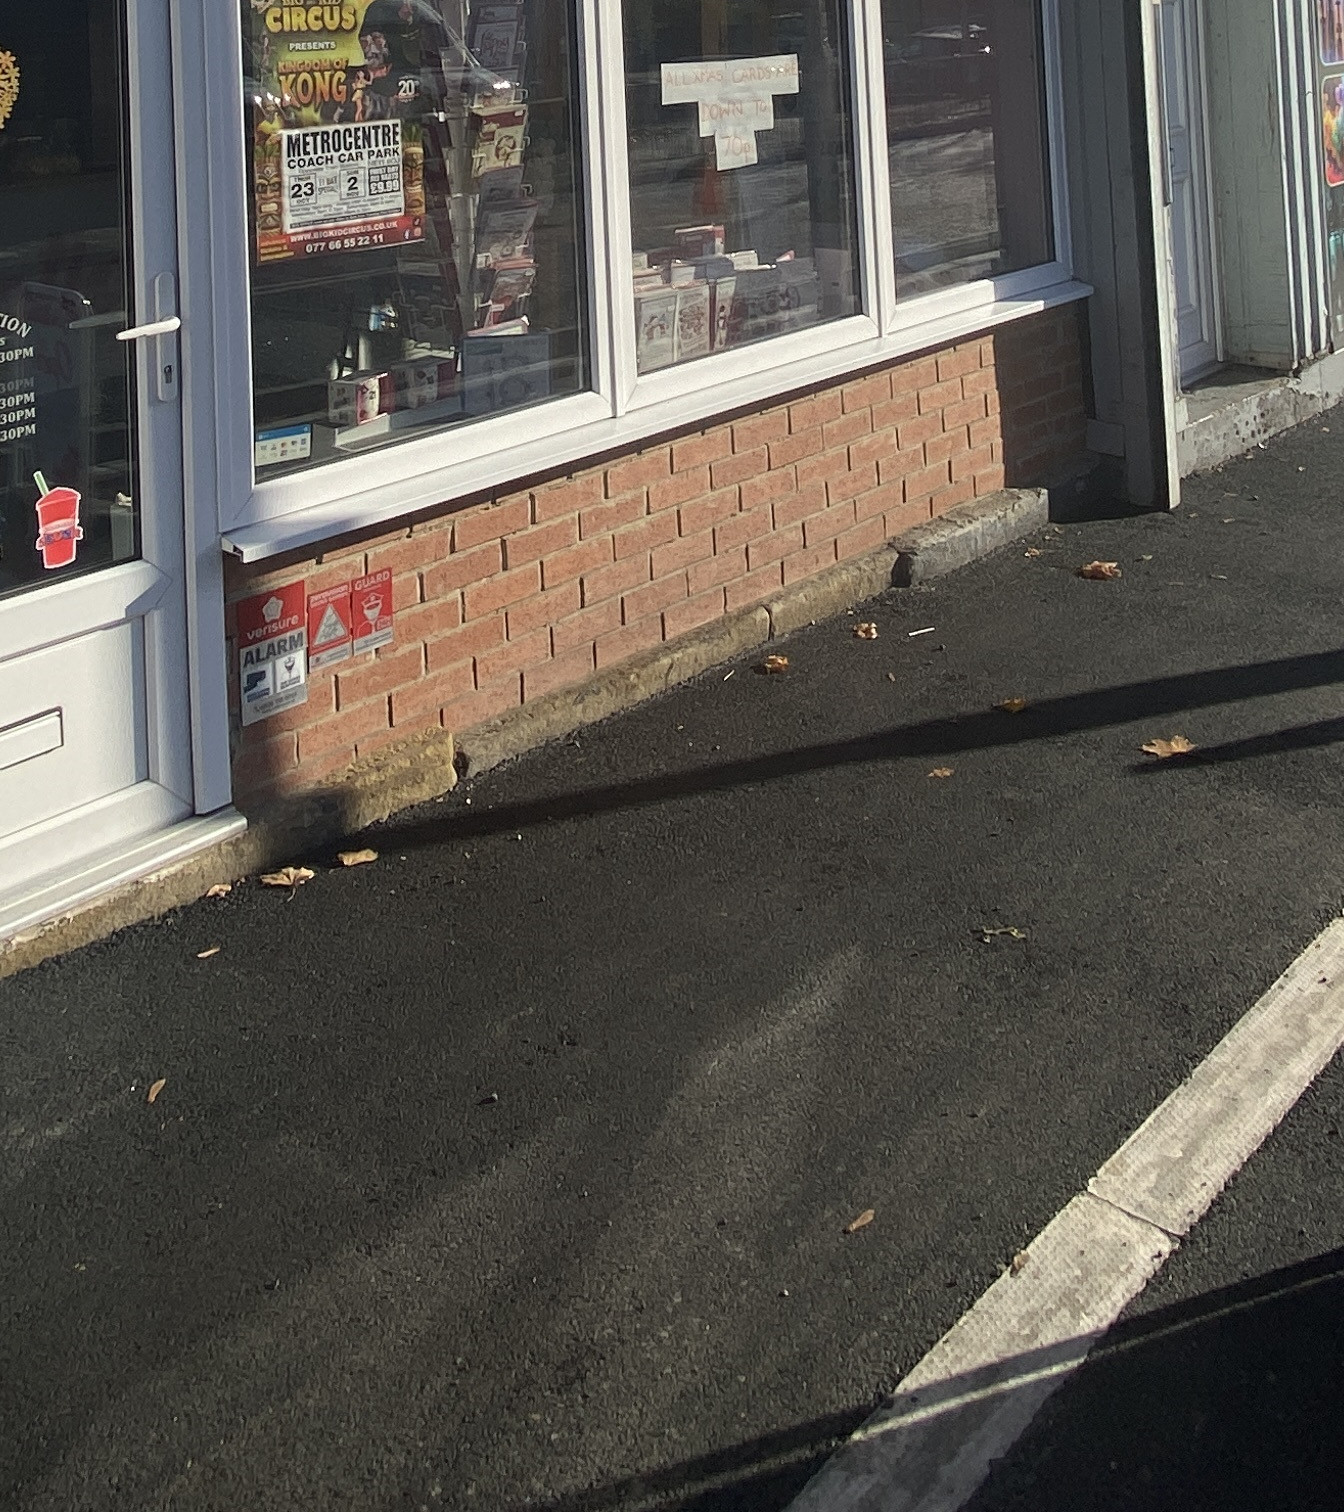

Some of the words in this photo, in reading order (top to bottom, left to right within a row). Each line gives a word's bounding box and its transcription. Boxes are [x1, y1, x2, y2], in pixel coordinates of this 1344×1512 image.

[264, 4, 356, 34] CIRCUS
[288, 41, 337, 52] PRESENTS
[277, 59, 333, 74] KINGDOM
[278, 69, 348, 109] KONG
[286, 123, 400, 159] METROCENTRE
[287, 154, 334, 170] COACH
[338, 150, 364, 164] CAR
[367, 146, 400, 160] PARK
[291, 182, 315, 199] 23
[347, 176, 359, 192] 2
[369, 179, 400, 195] £9.99
[305, 242, 326, 254] 077
[328, 239, 342, 250] 66
[343, 237, 356, 248] 55
[357, 235, 371, 246] 22
[373, 233, 384, 244] 11
[354, 570, 391, 591] GUARD
[246, 614, 300, 641] verisure
[242, 630, 305, 669] ALARM
